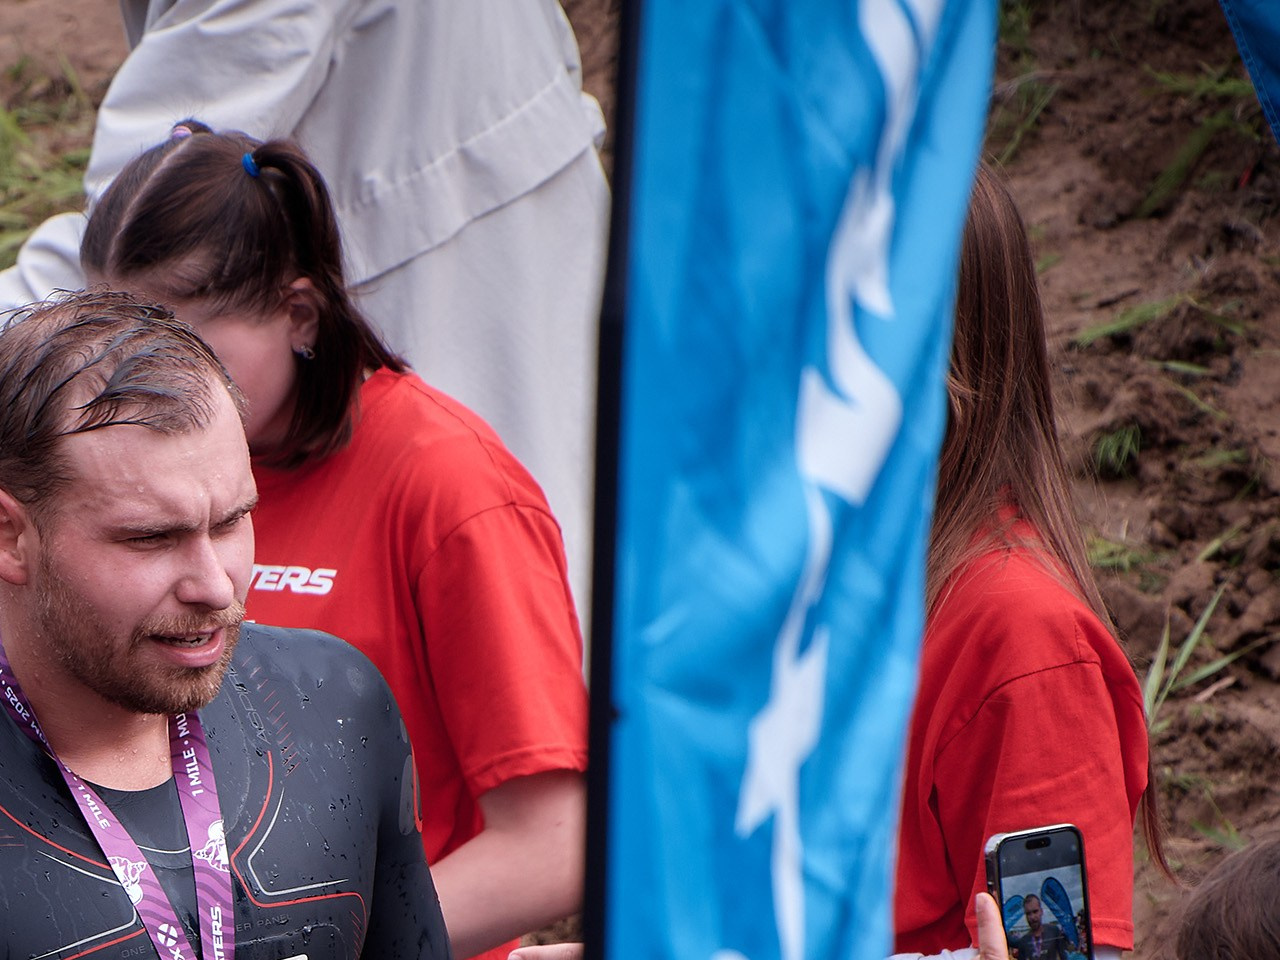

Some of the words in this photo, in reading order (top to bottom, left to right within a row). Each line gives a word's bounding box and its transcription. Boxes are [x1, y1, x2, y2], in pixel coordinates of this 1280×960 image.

[5, 686, 31, 721] 2025
[182, 747, 201, 787] MILE
[192, 789, 204, 797] 1
[82, 793, 112, 829] MILE
